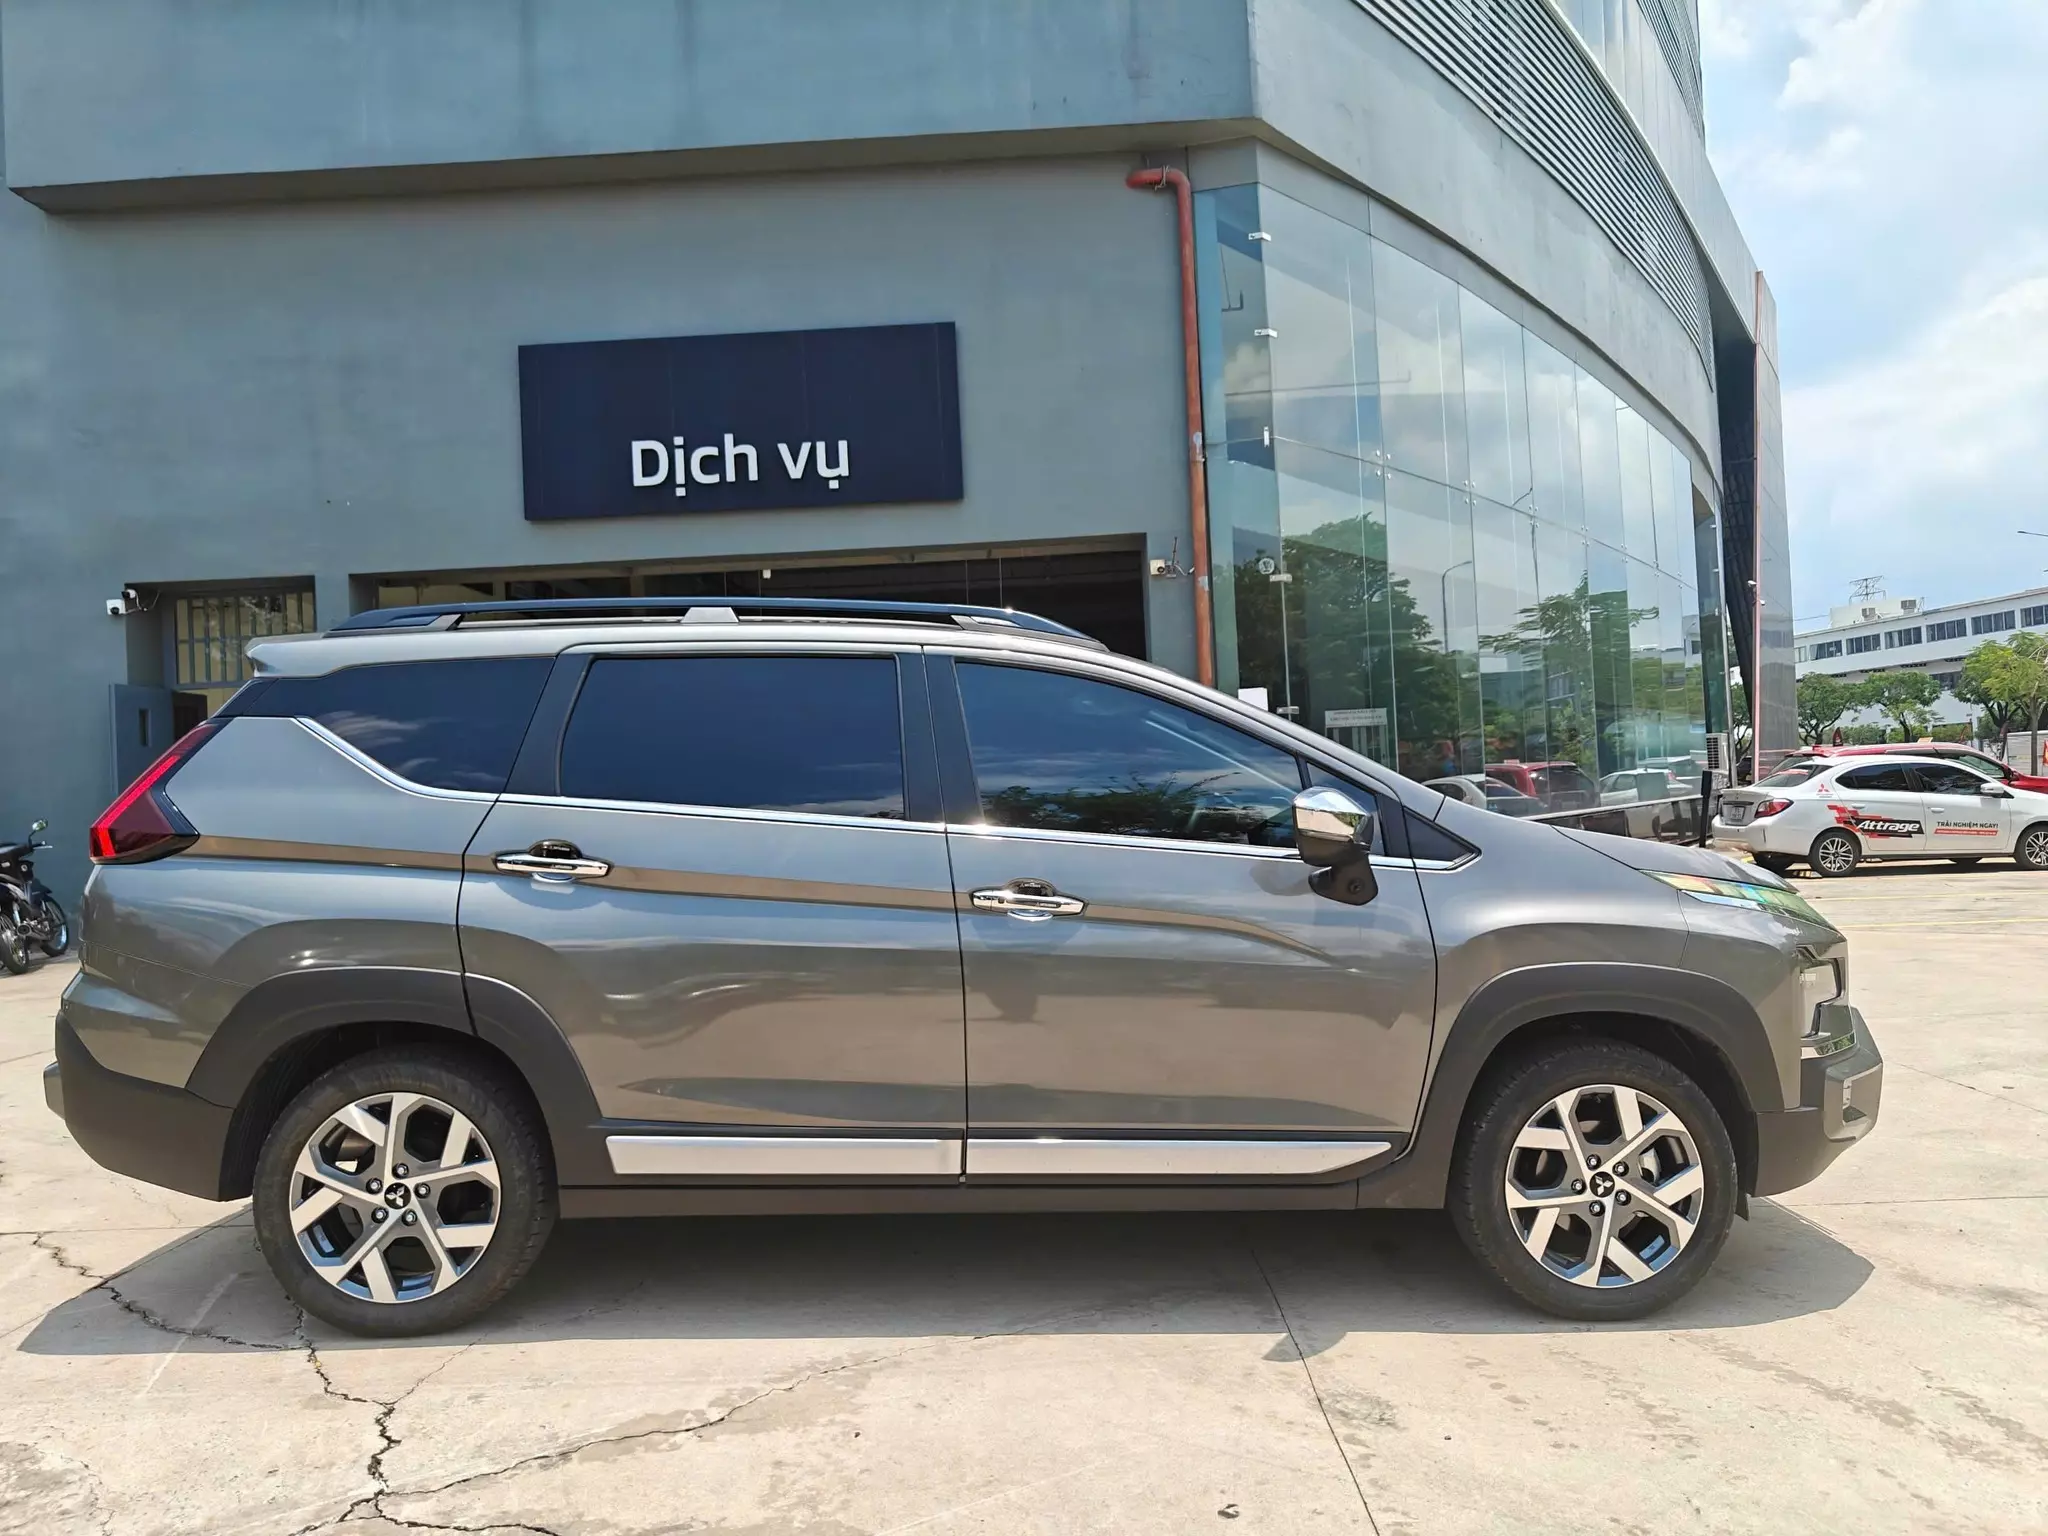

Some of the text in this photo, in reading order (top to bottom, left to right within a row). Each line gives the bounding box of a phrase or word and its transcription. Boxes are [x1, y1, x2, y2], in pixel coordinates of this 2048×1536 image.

[631, 433, 849, 497] Dịch vụ
[1856, 820, 1920, 833] Attrage
